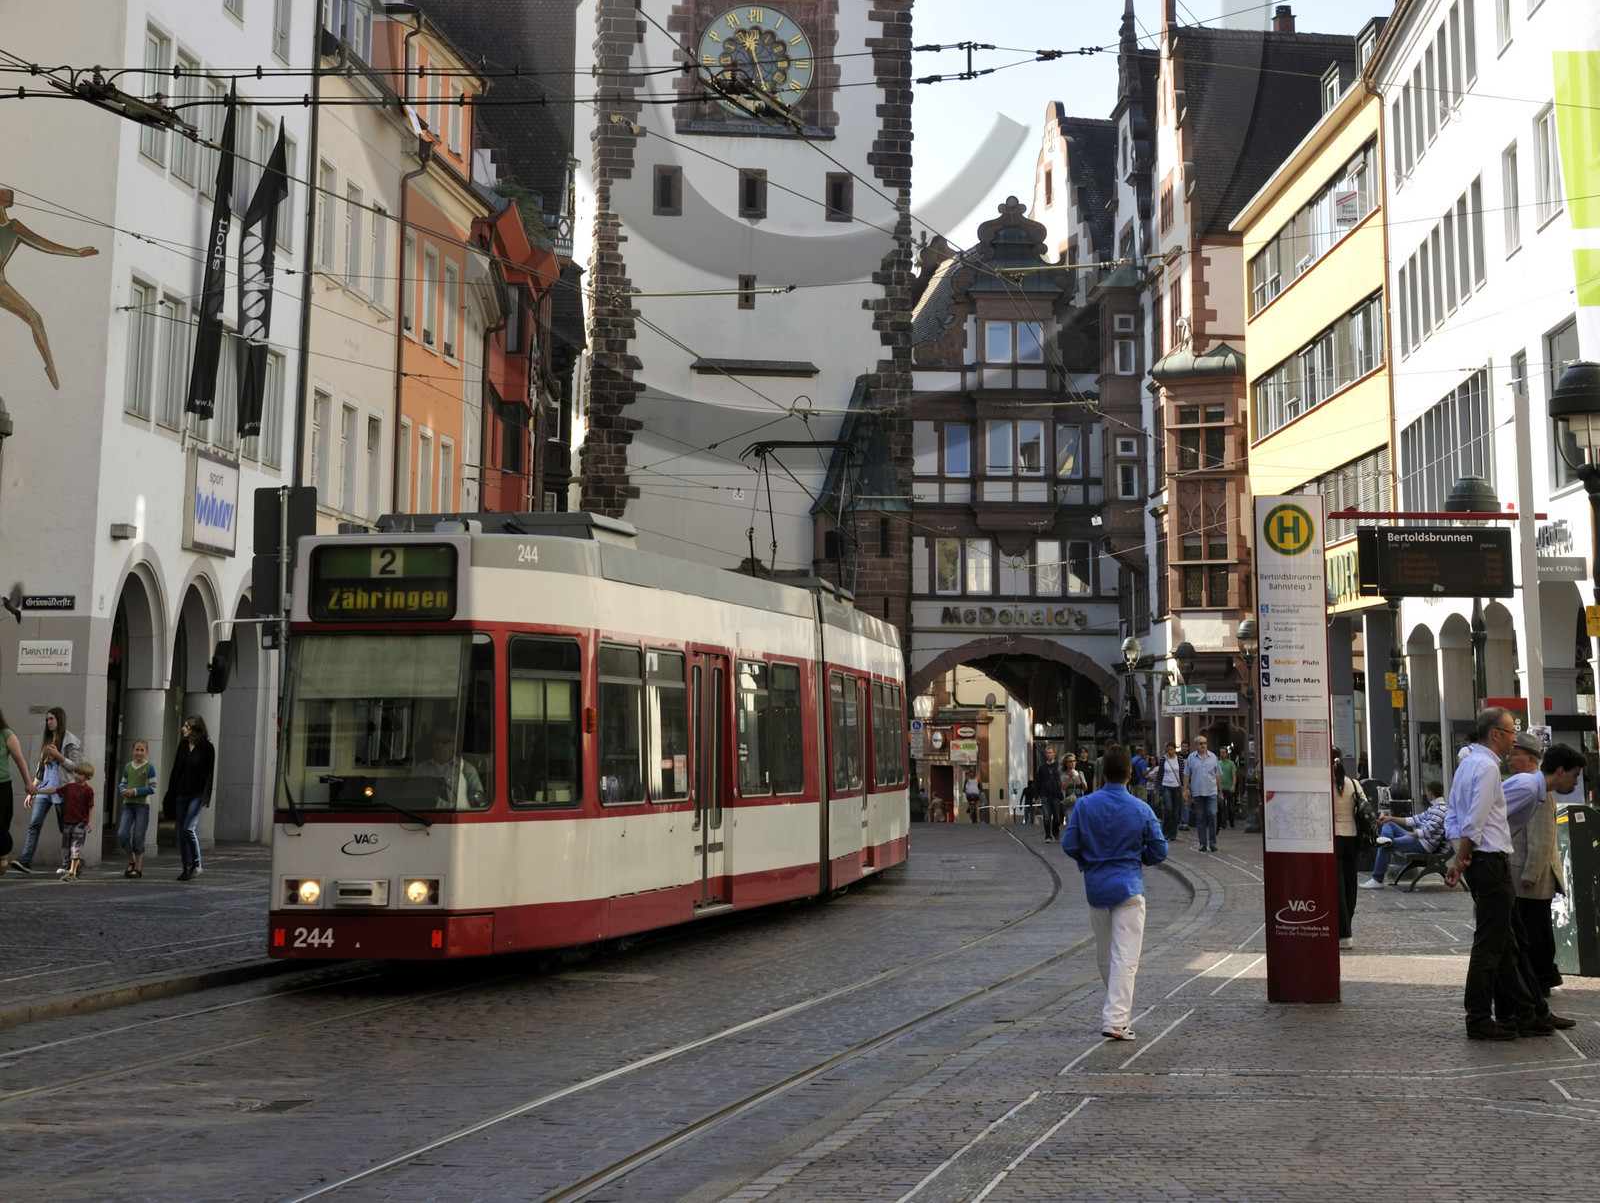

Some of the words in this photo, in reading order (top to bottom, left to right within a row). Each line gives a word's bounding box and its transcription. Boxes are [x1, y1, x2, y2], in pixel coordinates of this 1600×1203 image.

[212, 218, 228, 270] sport
[209, 472, 224, 486] sport
[1277, 516, 1300, 543] H
[1387, 532, 1473, 543] Bertoldsbrunnen
[379, 549, 396, 575] 2
[518, 544, 539, 563] 244
[1268, 583, 1306, 591] Bahnsteig
[328, 587, 448, 611] Zähringen
[941, 606, 1087, 626] McDonald's
[354, 834, 378, 844] VAG
[1288, 900, 1316, 912] VAG
[293, 927, 334, 948] 244
